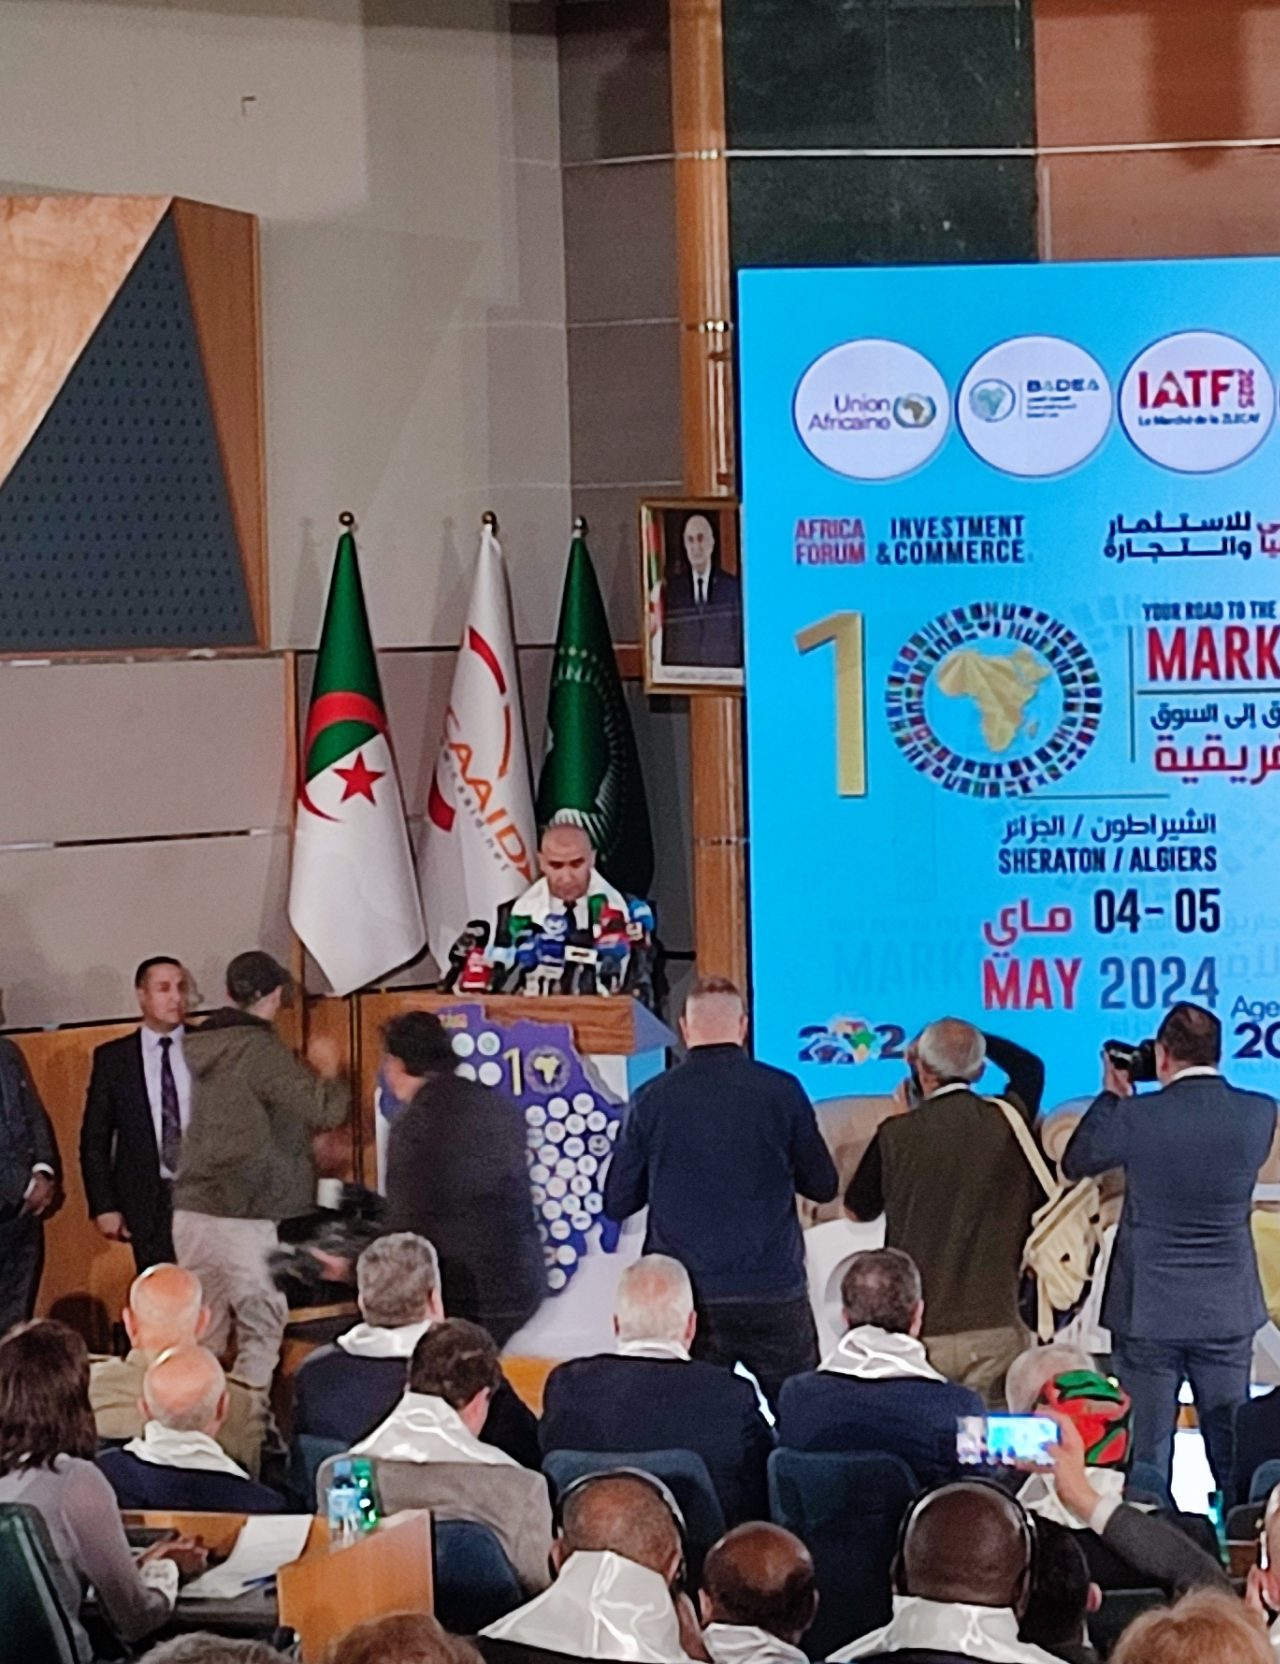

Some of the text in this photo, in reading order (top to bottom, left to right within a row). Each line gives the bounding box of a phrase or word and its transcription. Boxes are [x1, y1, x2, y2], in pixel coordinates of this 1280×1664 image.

[1027, 377, 1100, 393] BADEA
[1138, 369, 1234, 409] IATF
[834, 394, 890, 413] Union
[808, 412, 890, 432] Africaine
[795, 518, 865, 539] AFRICA
[890, 515, 1026, 540] INVESTMENT
[795, 542, 866, 566] FORUM
[1142, 603, 1182, 621] YOUR
[1185, 602, 1224, 620] ROAD
[1227, 601, 1246, 619] TO
[1250, 600, 1276, 619] THE
[1150, 703, 1218, 730] السوق
[1091, 808, 1216, 844] الشيراطون
[998, 848, 1105, 875] SHERATON
[1129, 846, 1217, 873] ALGIERS
[982, 898, 1073, 958] ماي
[982, 957, 1083, 1010] MAY
[1100, 956, 1221, 1010] 2024
